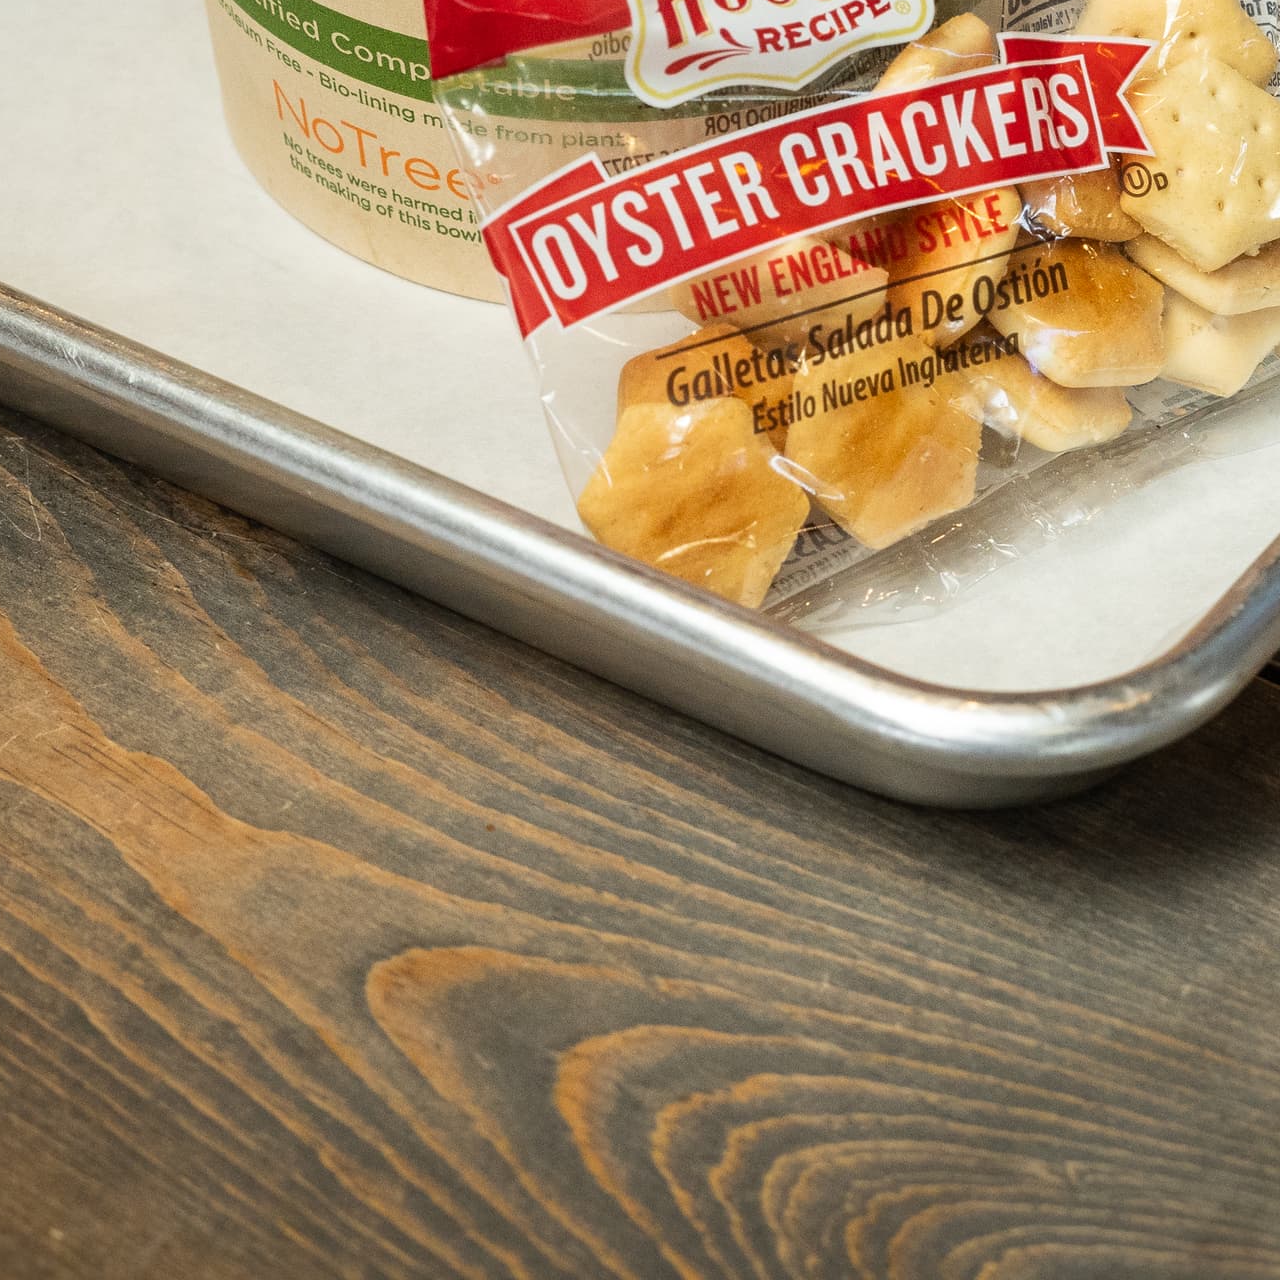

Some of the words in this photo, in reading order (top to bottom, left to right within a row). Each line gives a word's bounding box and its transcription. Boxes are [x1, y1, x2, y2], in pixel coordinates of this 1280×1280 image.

[266, 39, 303, 73] Free
[319, 71, 416, 124] Bio-lining
[495, 124, 553, 146] from
[283, 132, 304, 156] No
[306, 144, 344, 180] trees
[347, 170, 388, 199] were
[392, 188, 463, 222] harmed
[290, 154, 313, 179] the
[315, 172, 372, 212] making
[376, 204, 395, 219] of
[399, 209, 431, 231] this
[436, 220, 482, 244] bowl
[531, 151, 781, 301] OYSTER
[779, 74, 1090, 208] CRACKERS
[690, 265, 762, 321] NEW
[769, 222, 911, 298] ENGLAND
[918, 194, 1009, 255] STYLE
[666, 339, 799, 408] Galletas
[808, 303, 914, 366] Salada
[922, 288, 965, 331] De
[972, 258, 1070, 316] Ostión
[752, 394, 816, 435] Estilo
[822, 365, 895, 413] Nueva
[899, 330, 1020, 388] Inglaterra
